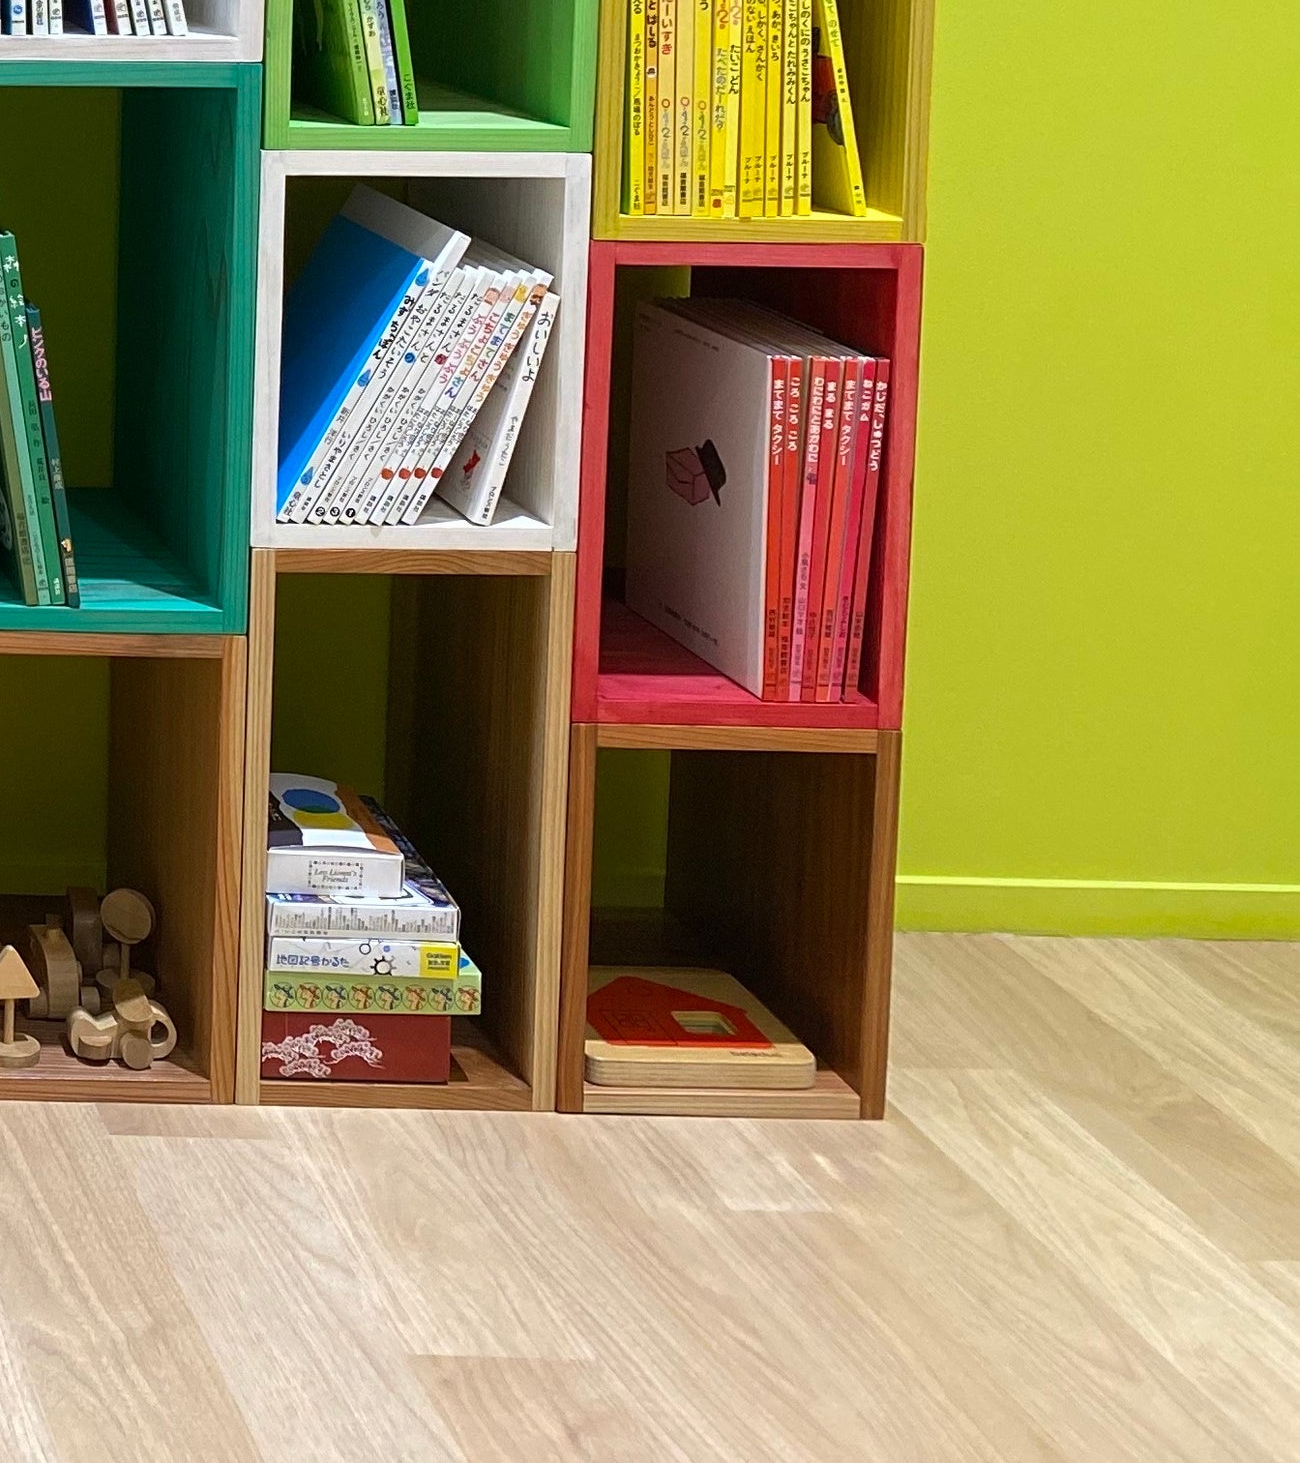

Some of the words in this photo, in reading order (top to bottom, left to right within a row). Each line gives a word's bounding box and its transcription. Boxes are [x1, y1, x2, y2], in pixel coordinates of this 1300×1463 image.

[2, 254, 27, 328] 森の絵本
[419, 291, 467, 364] だるまさんと
[521, 311, 554, 382] おいしいよ
[771, 425, 784, 466] タクシー
[276, 953, 350, 969] 地図記号かるた
